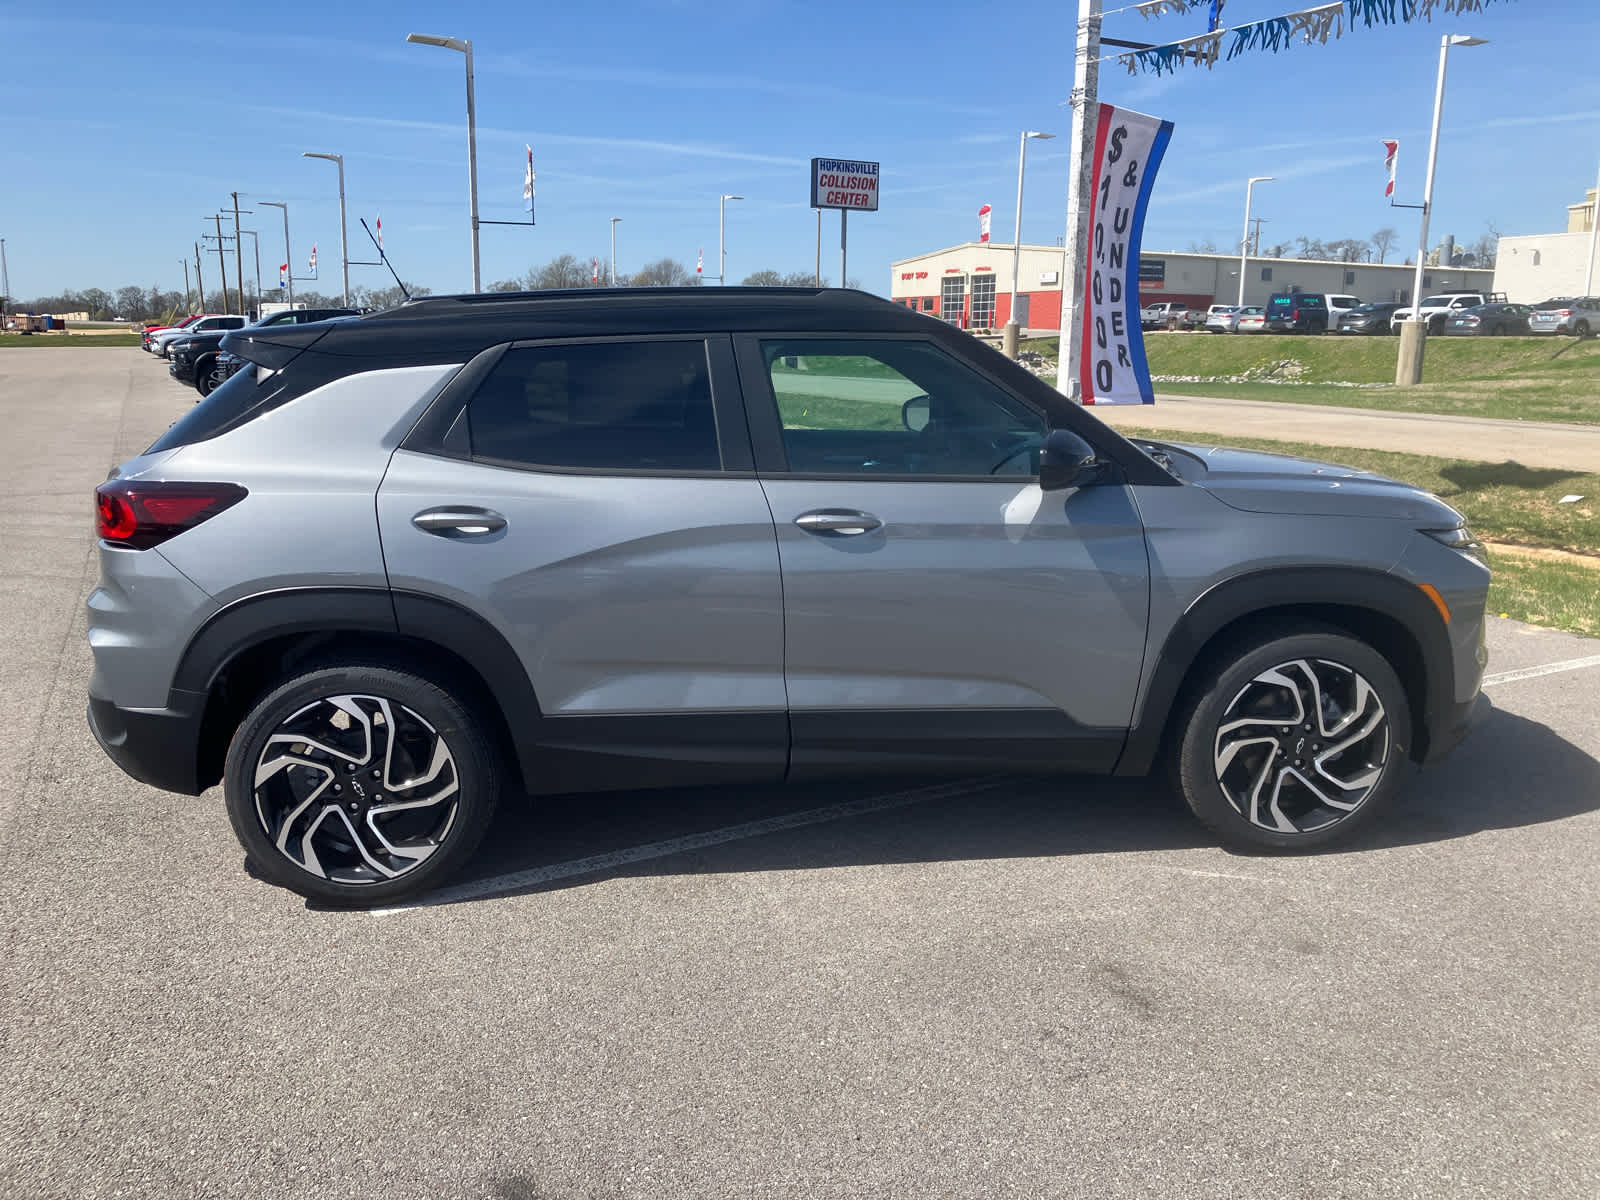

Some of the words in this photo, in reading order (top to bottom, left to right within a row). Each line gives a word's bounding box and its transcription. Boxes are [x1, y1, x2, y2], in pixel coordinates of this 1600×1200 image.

[820, 160, 876, 174] HOPKINSVILLE
[820, 174, 876, 190] COLLISION
[826, 191, 869, 207] CENTER
[901, 272, 914, 280] BODY
[1110, 207, 1131, 367] UNDER
